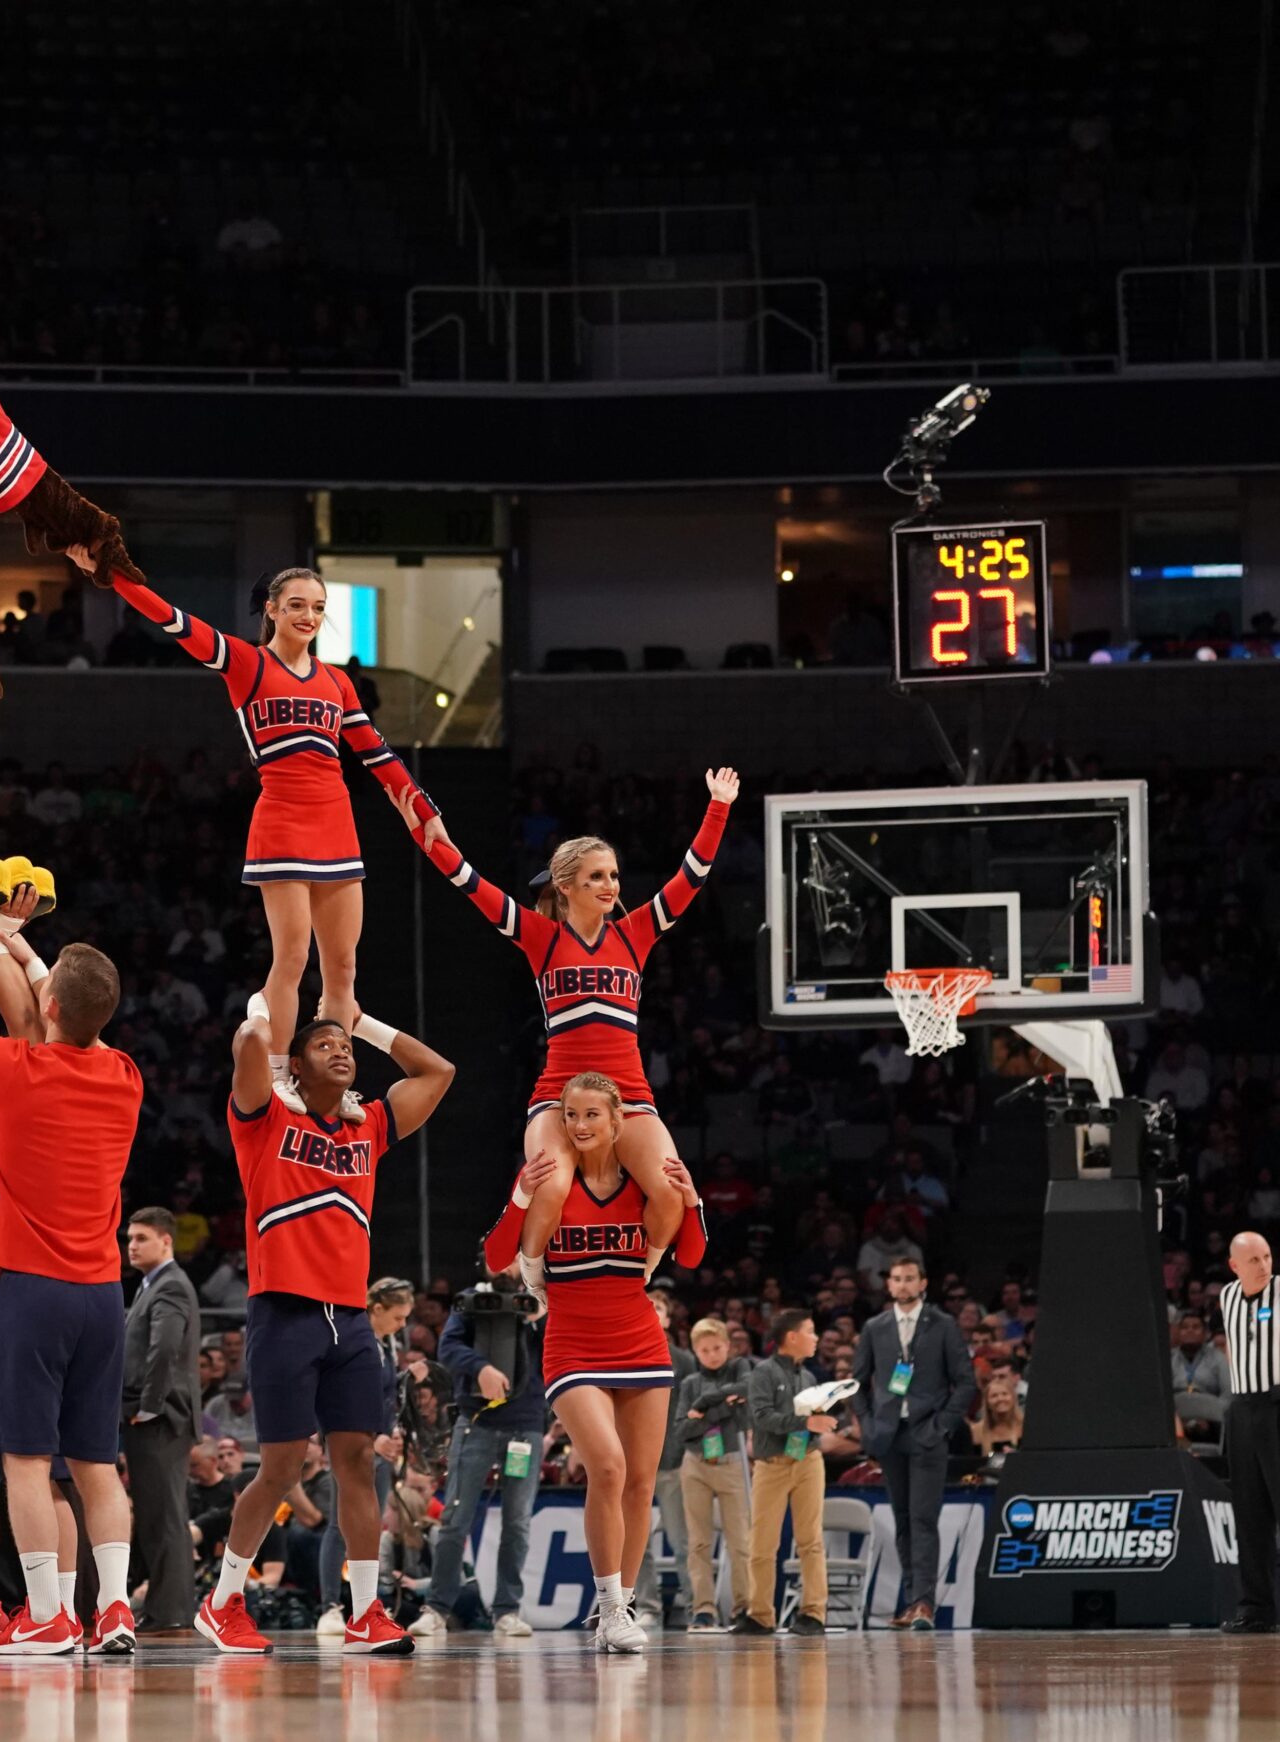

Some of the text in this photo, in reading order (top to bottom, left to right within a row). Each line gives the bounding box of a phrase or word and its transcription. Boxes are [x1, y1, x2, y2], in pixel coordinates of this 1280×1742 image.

[933, 529, 1006, 541] DAKTRONICS
[939, 538, 1030, 580] 4:25
[931, 588, 1017, 663] 27
[250, 696, 343, 737] LIBERT
[543, 966, 640, 1001] LIBERTY
[1034, 1501, 1131, 1531] MARCH
[1045, 1529, 1175, 1561] MADNESS
